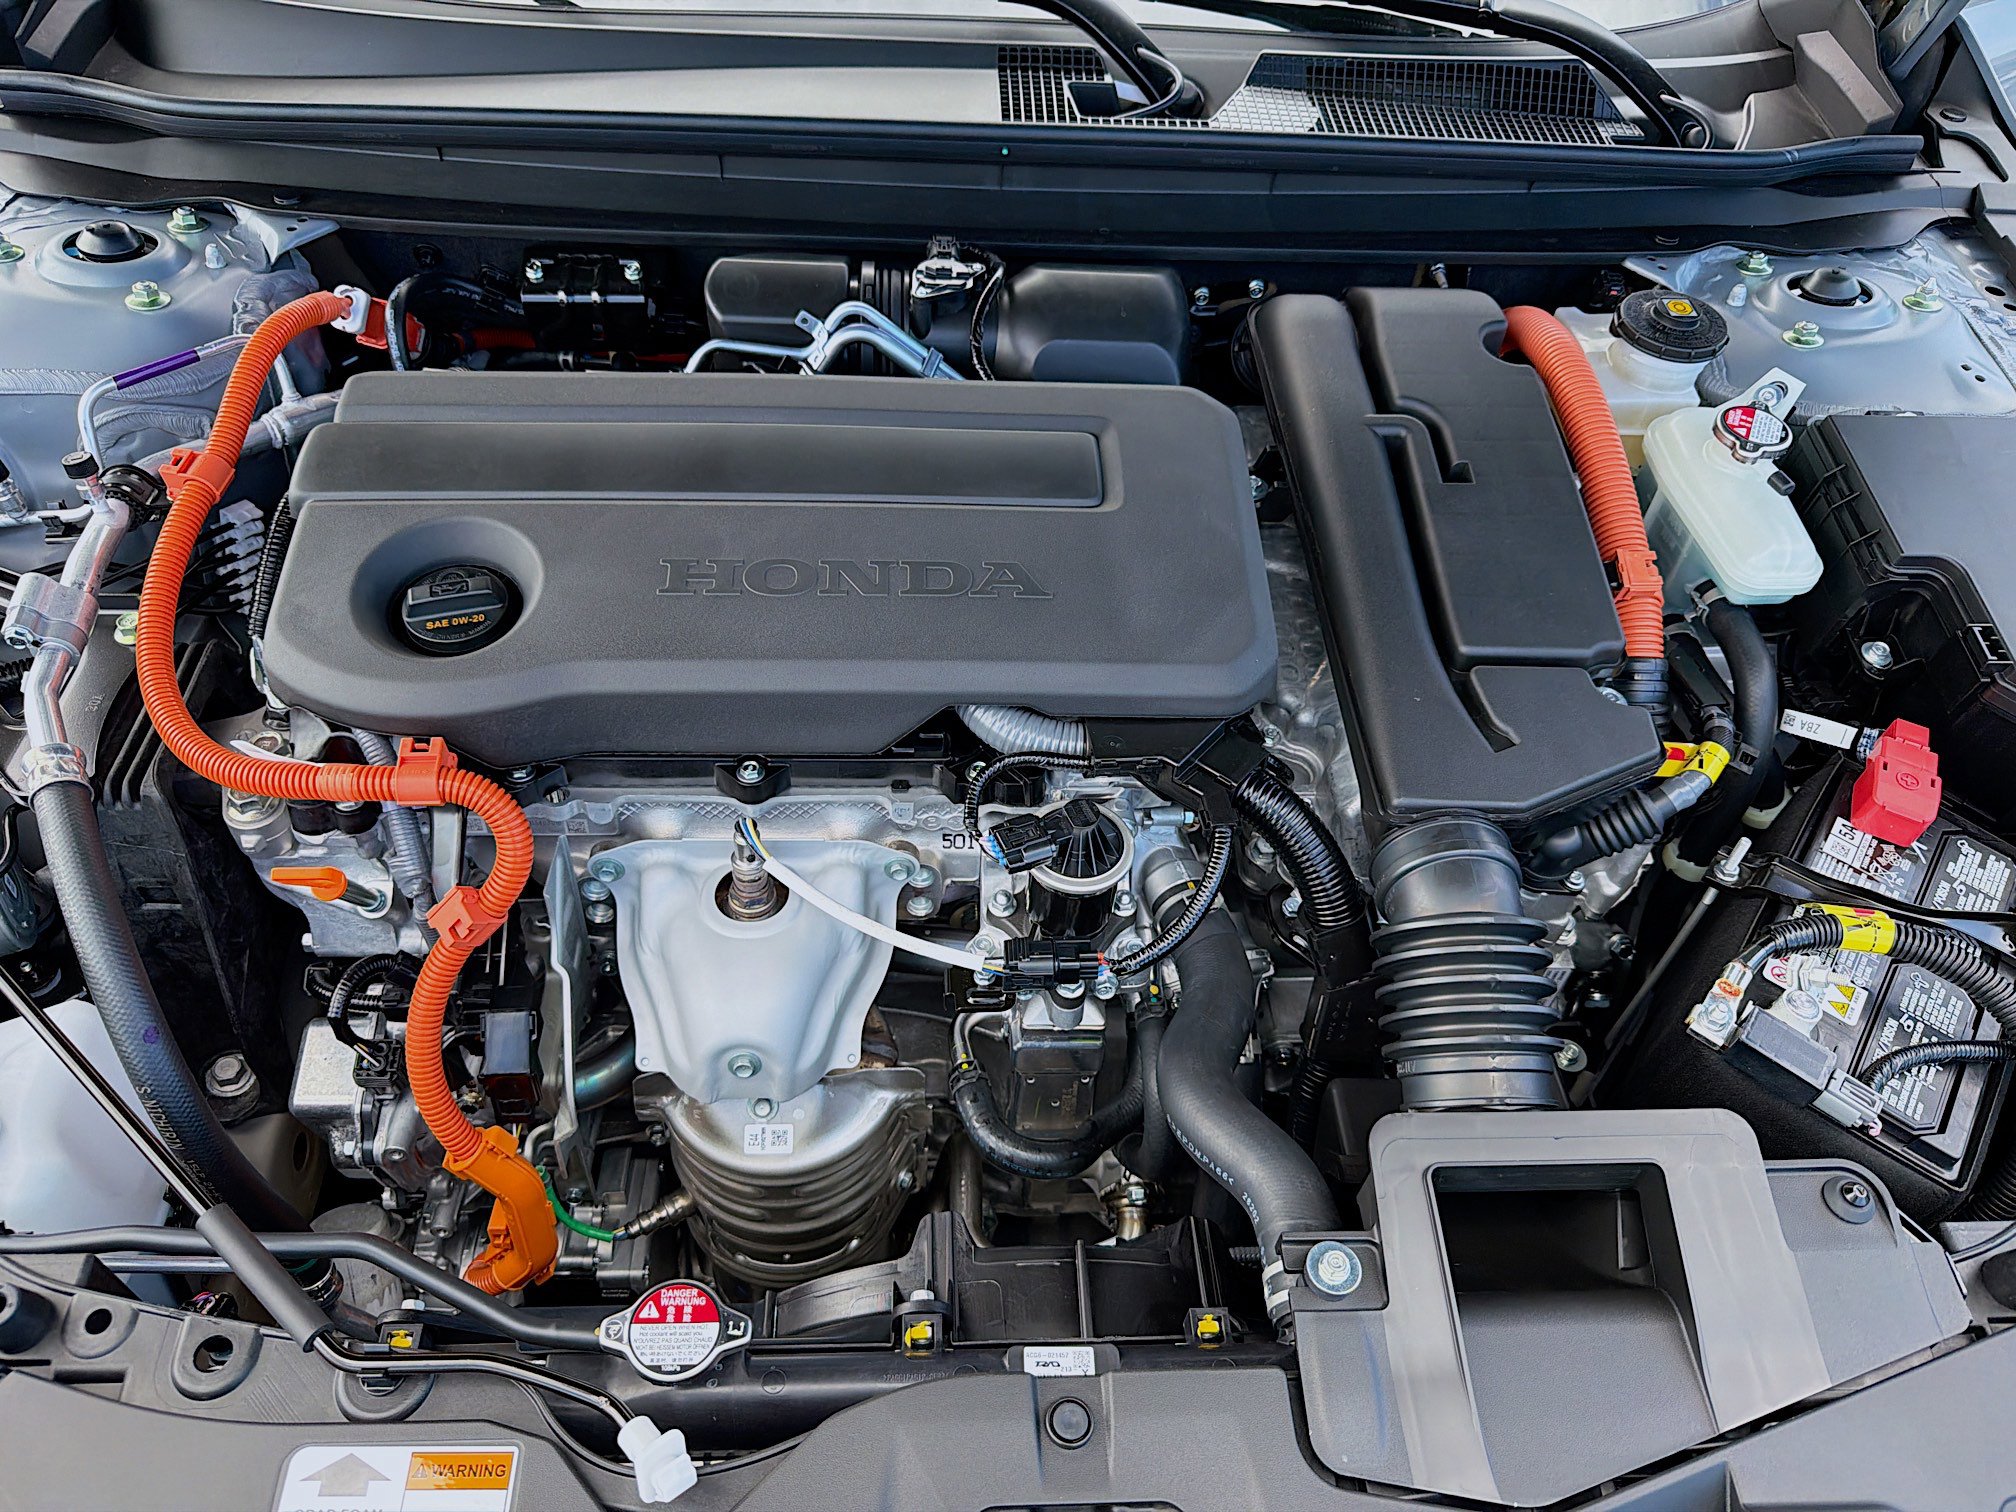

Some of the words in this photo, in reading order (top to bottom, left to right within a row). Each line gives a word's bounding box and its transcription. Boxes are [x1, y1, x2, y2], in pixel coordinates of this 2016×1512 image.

[656, 557, 1053, 599] HONDA
[425, 619, 450, 630] SAE
[451, 613, 486, 627] 0W-20
[661, 1288, 699, 1297] DANGER
[660, 1296, 707, 1306] WARNUNG
[431, 1463, 507, 1479] WARNING
